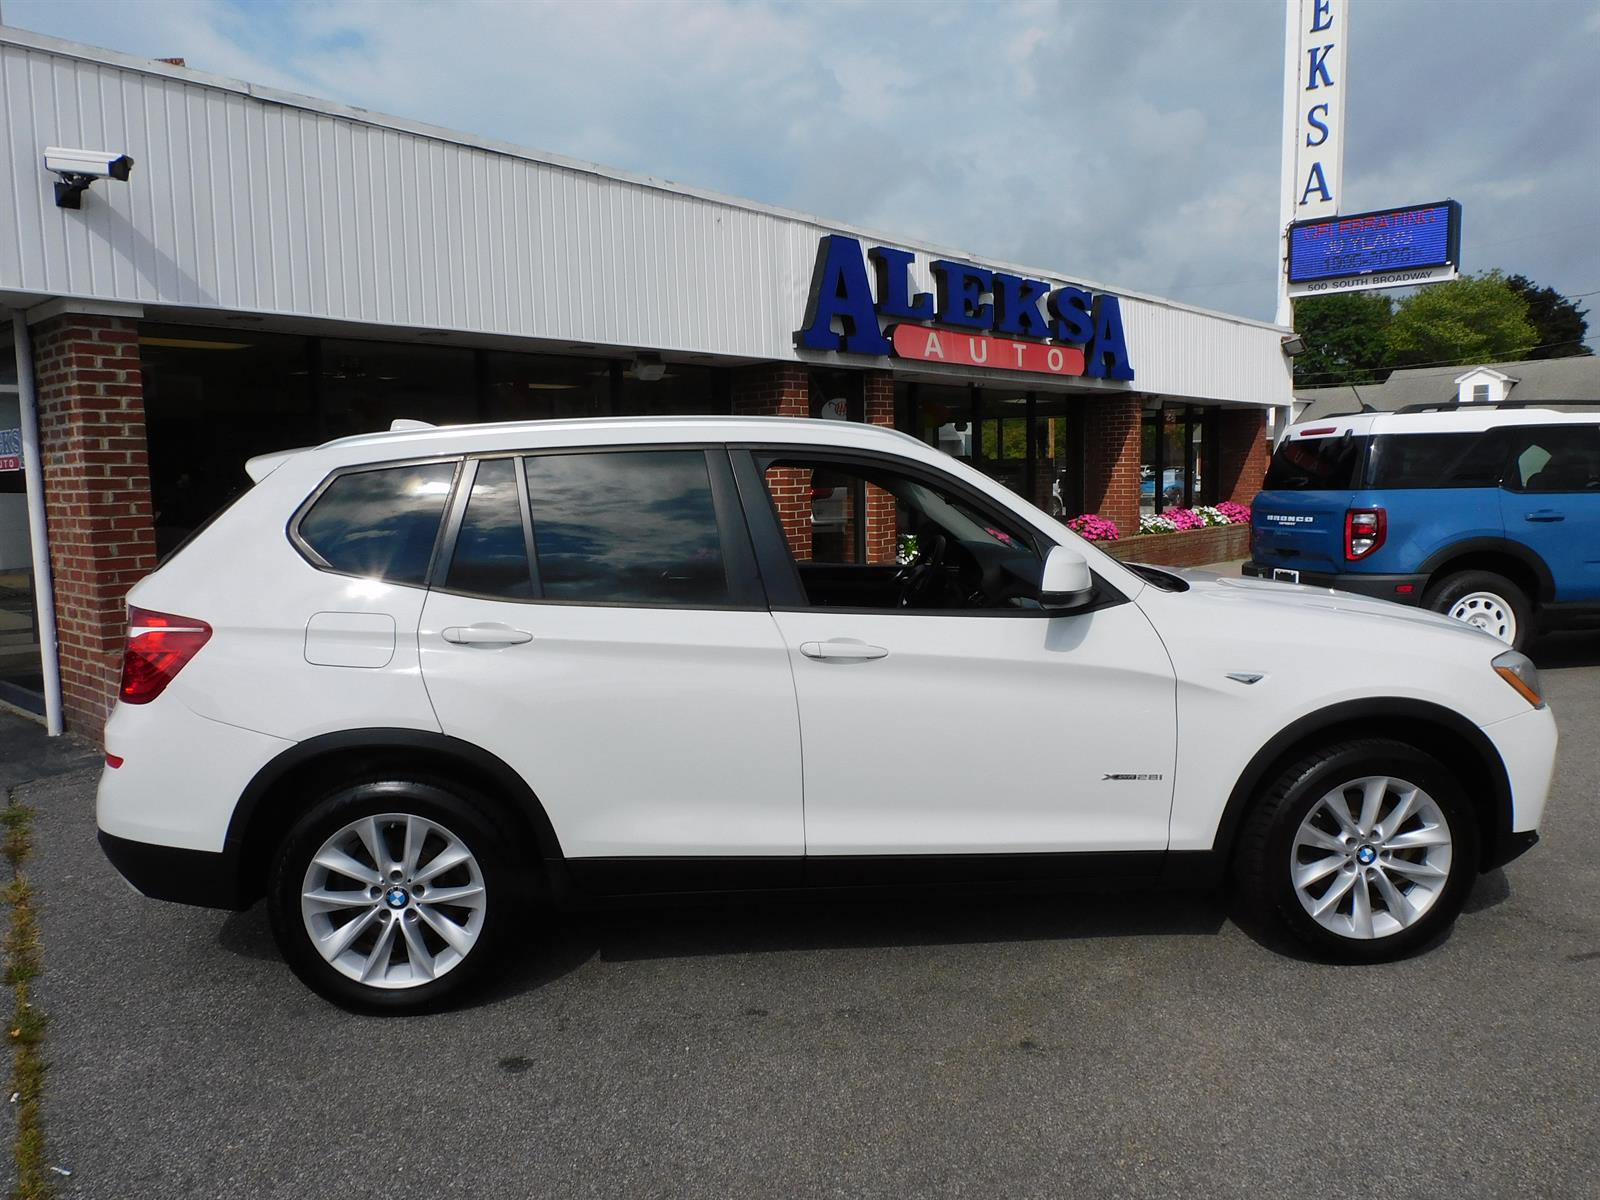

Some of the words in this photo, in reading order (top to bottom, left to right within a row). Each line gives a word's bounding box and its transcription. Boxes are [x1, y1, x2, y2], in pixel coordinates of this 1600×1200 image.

[1307, 282, 1328, 292] 500
[1332, 278, 1368, 290] SOUTH
[1372, 271, 1433, 284] BROADWAY
[793, 234, 1134, 380] ALEKSA
[924, 332, 1064, 372] AUTO
